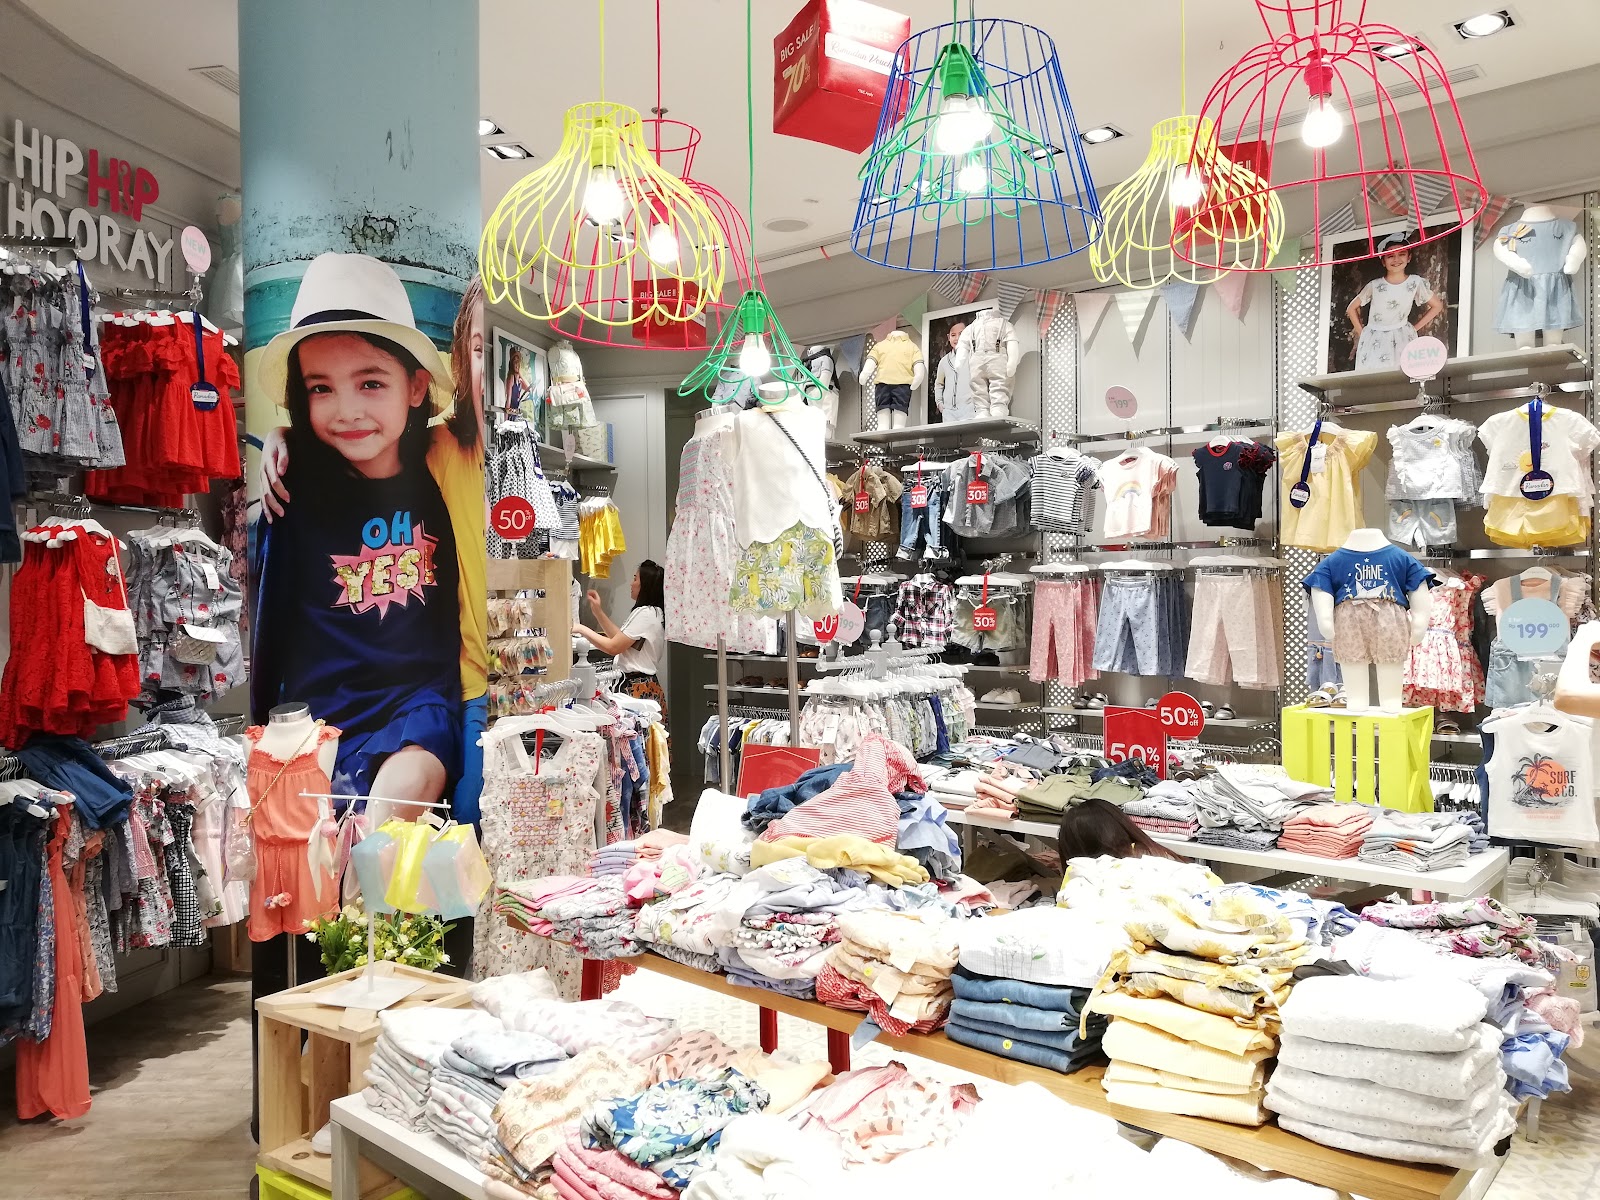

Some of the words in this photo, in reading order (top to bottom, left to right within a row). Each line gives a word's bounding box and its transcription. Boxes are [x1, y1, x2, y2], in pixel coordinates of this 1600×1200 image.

[780, 43, 795, 62] BIG
[830, 40, 867, 61] Ramadan
[15, 118, 84, 199] HIP
[88, 148, 160, 222] HIP
[8, 182, 174, 284] HOORAY
[1407, 347, 1440, 360] NEW
[362, 510, 413, 549] OH
[336, 544, 435, 604] YES!
[1517, 623, 1548, 638] 199
[1160, 706, 1198, 726] 50%
[1549, 770, 1577, 785] SURF
